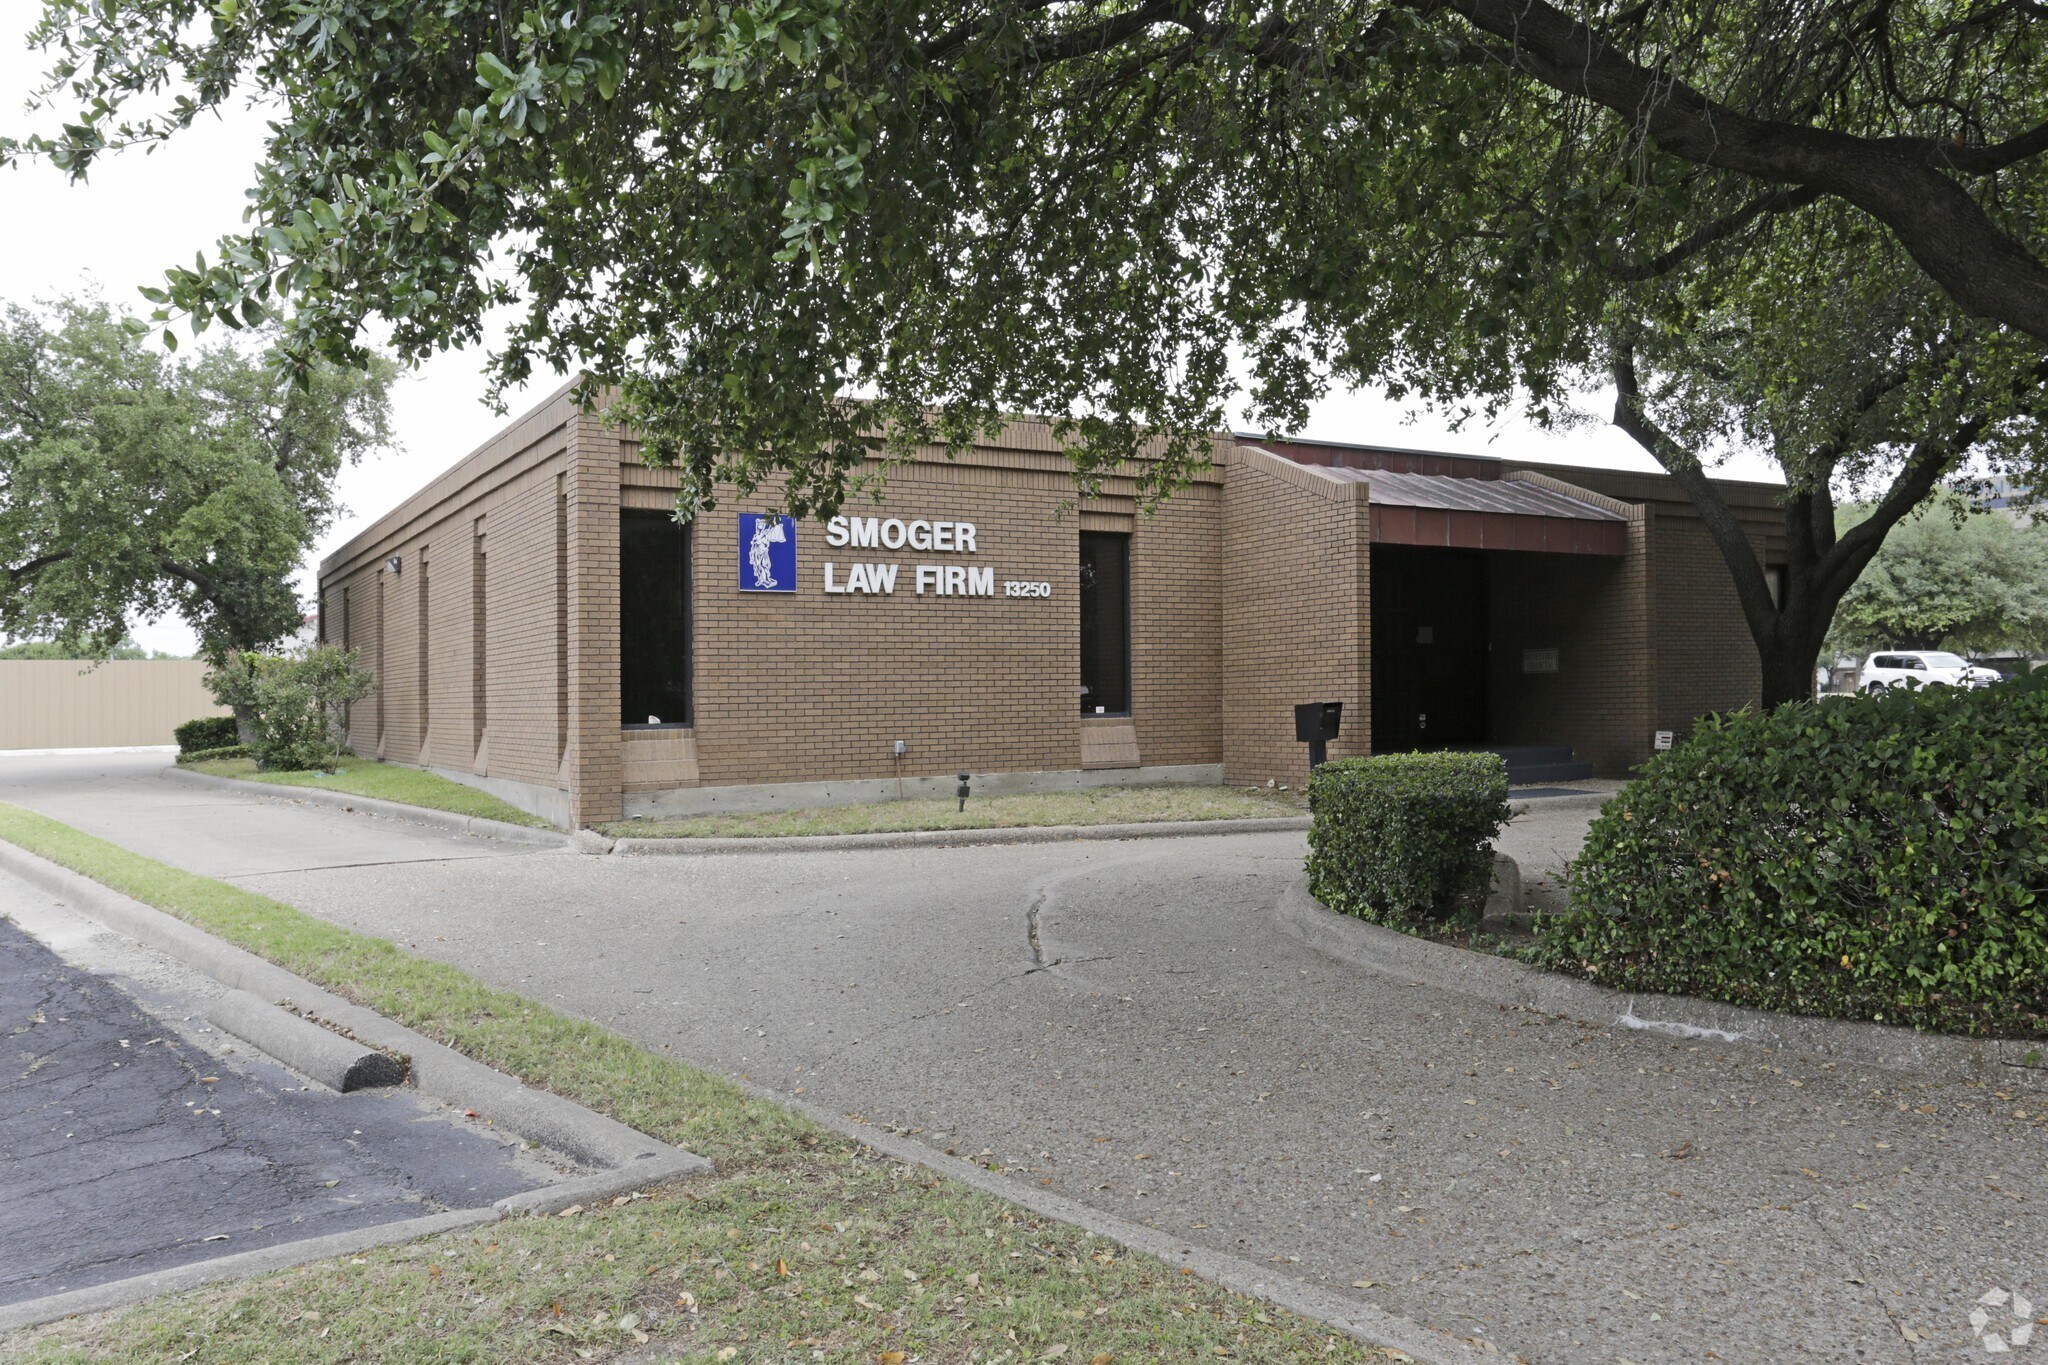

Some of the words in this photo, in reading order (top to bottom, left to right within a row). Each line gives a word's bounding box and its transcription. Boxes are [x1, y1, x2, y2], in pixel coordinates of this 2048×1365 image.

[825, 515, 977, 552] SMOGER
[823, 562, 898, 594] LAW
[915, 564, 995, 596] FIRM
[1003, 580, 1051, 597] 13250
